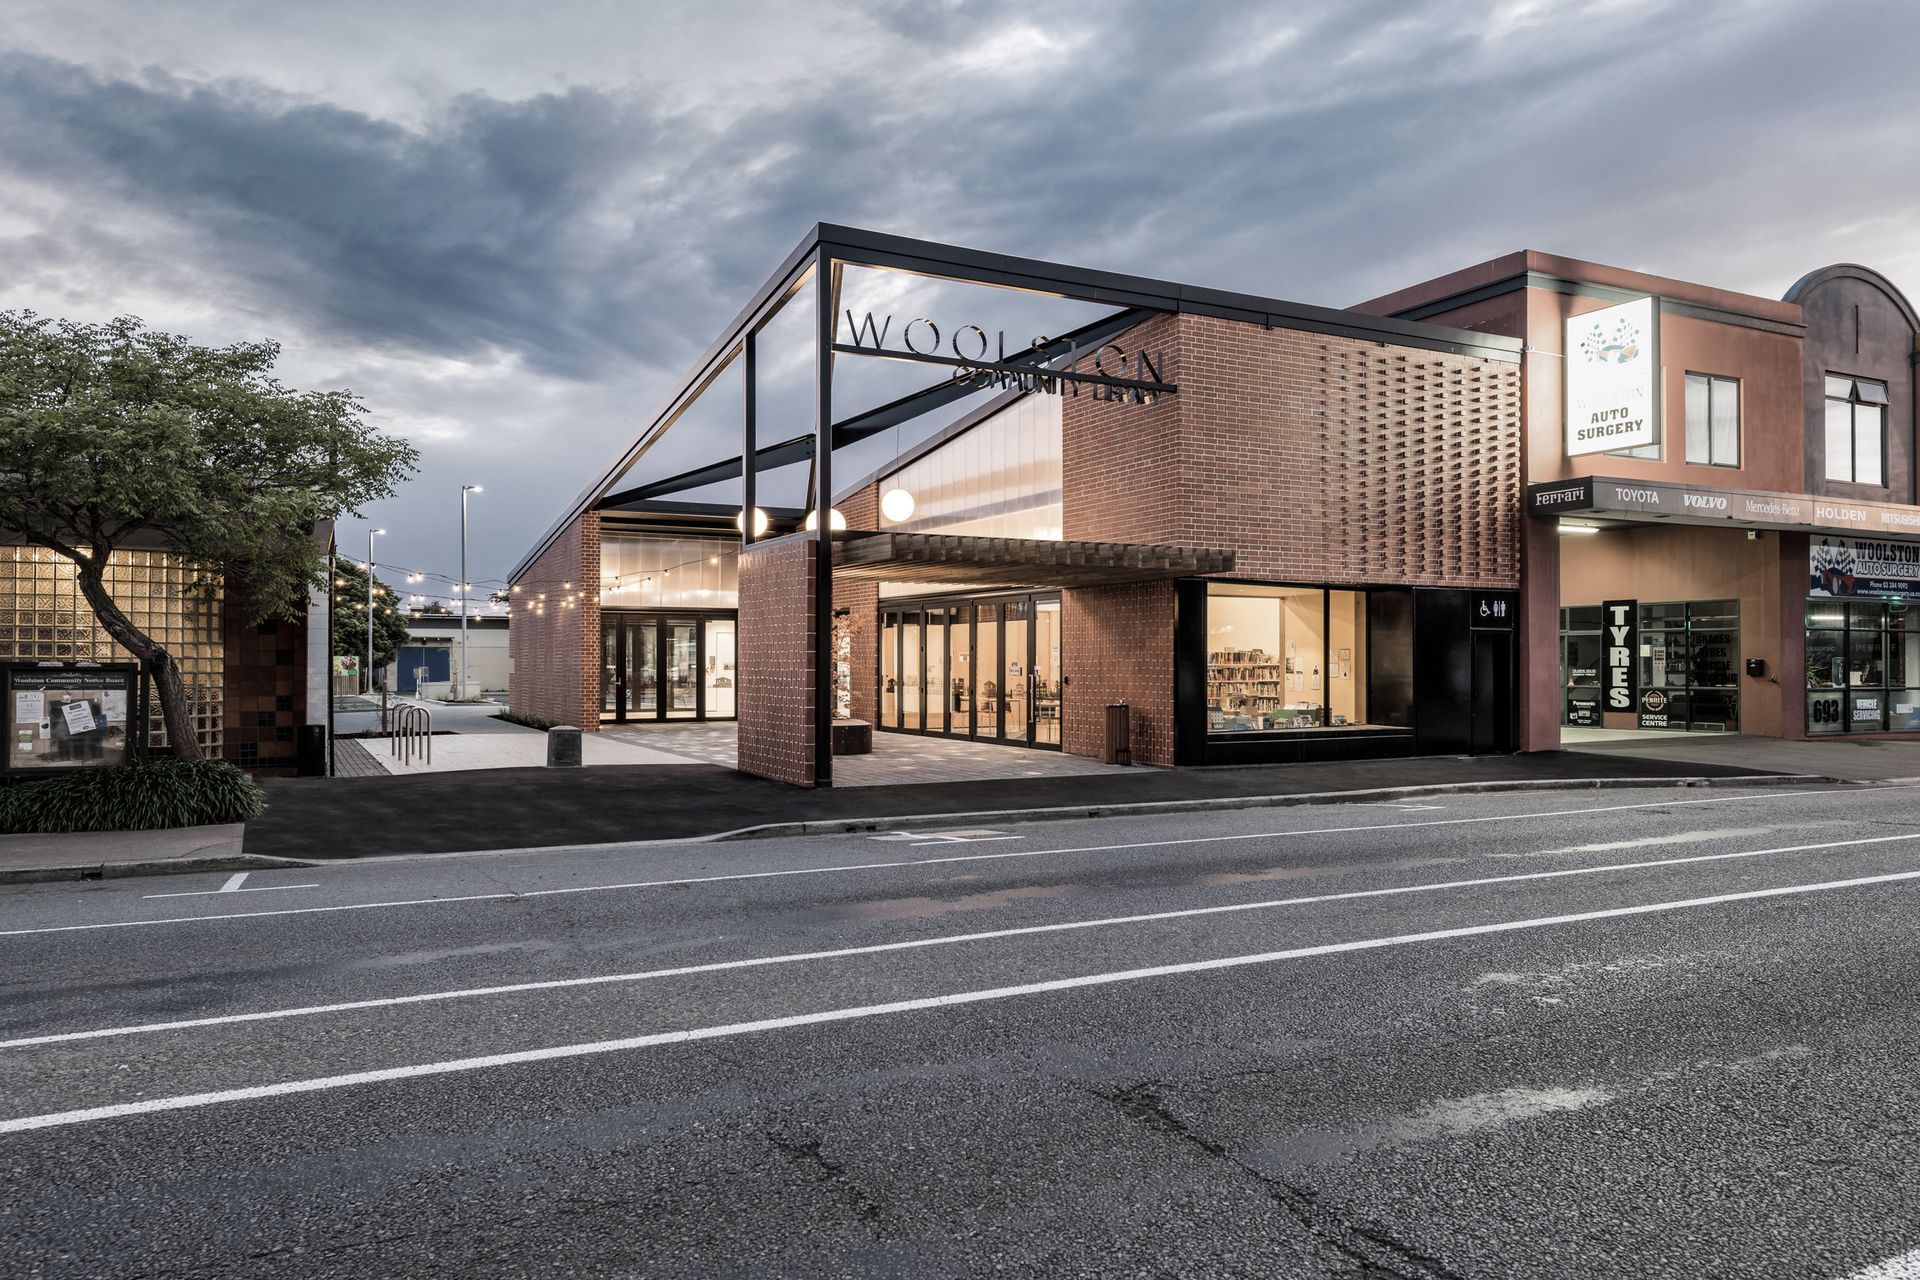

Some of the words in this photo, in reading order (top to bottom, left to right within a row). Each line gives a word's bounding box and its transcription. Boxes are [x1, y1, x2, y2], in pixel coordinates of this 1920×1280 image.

[845, 309, 1163, 384] WOOLSTON
[1590, 406, 1629, 424] AUTO
[1577, 419, 1644, 441] SURGERY
[1535, 487, 1585, 506] Ferrari
[1616, 488, 1660, 504] TOYOTA
[1683, 494, 1727, 510] VOLVO
[1745, 500, 1801, 516] Mercedes-Benz
[1816, 507, 1866, 522] HOLDEN
[1855, 542, 1920, 563] WOOLSTON
[1856, 561, 1880, 575] AUTO
[1881, 562, 1919, 577] SURGERY
[1609, 605, 1630, 708] TYRES
[1813, 699, 1839, 723] 693
